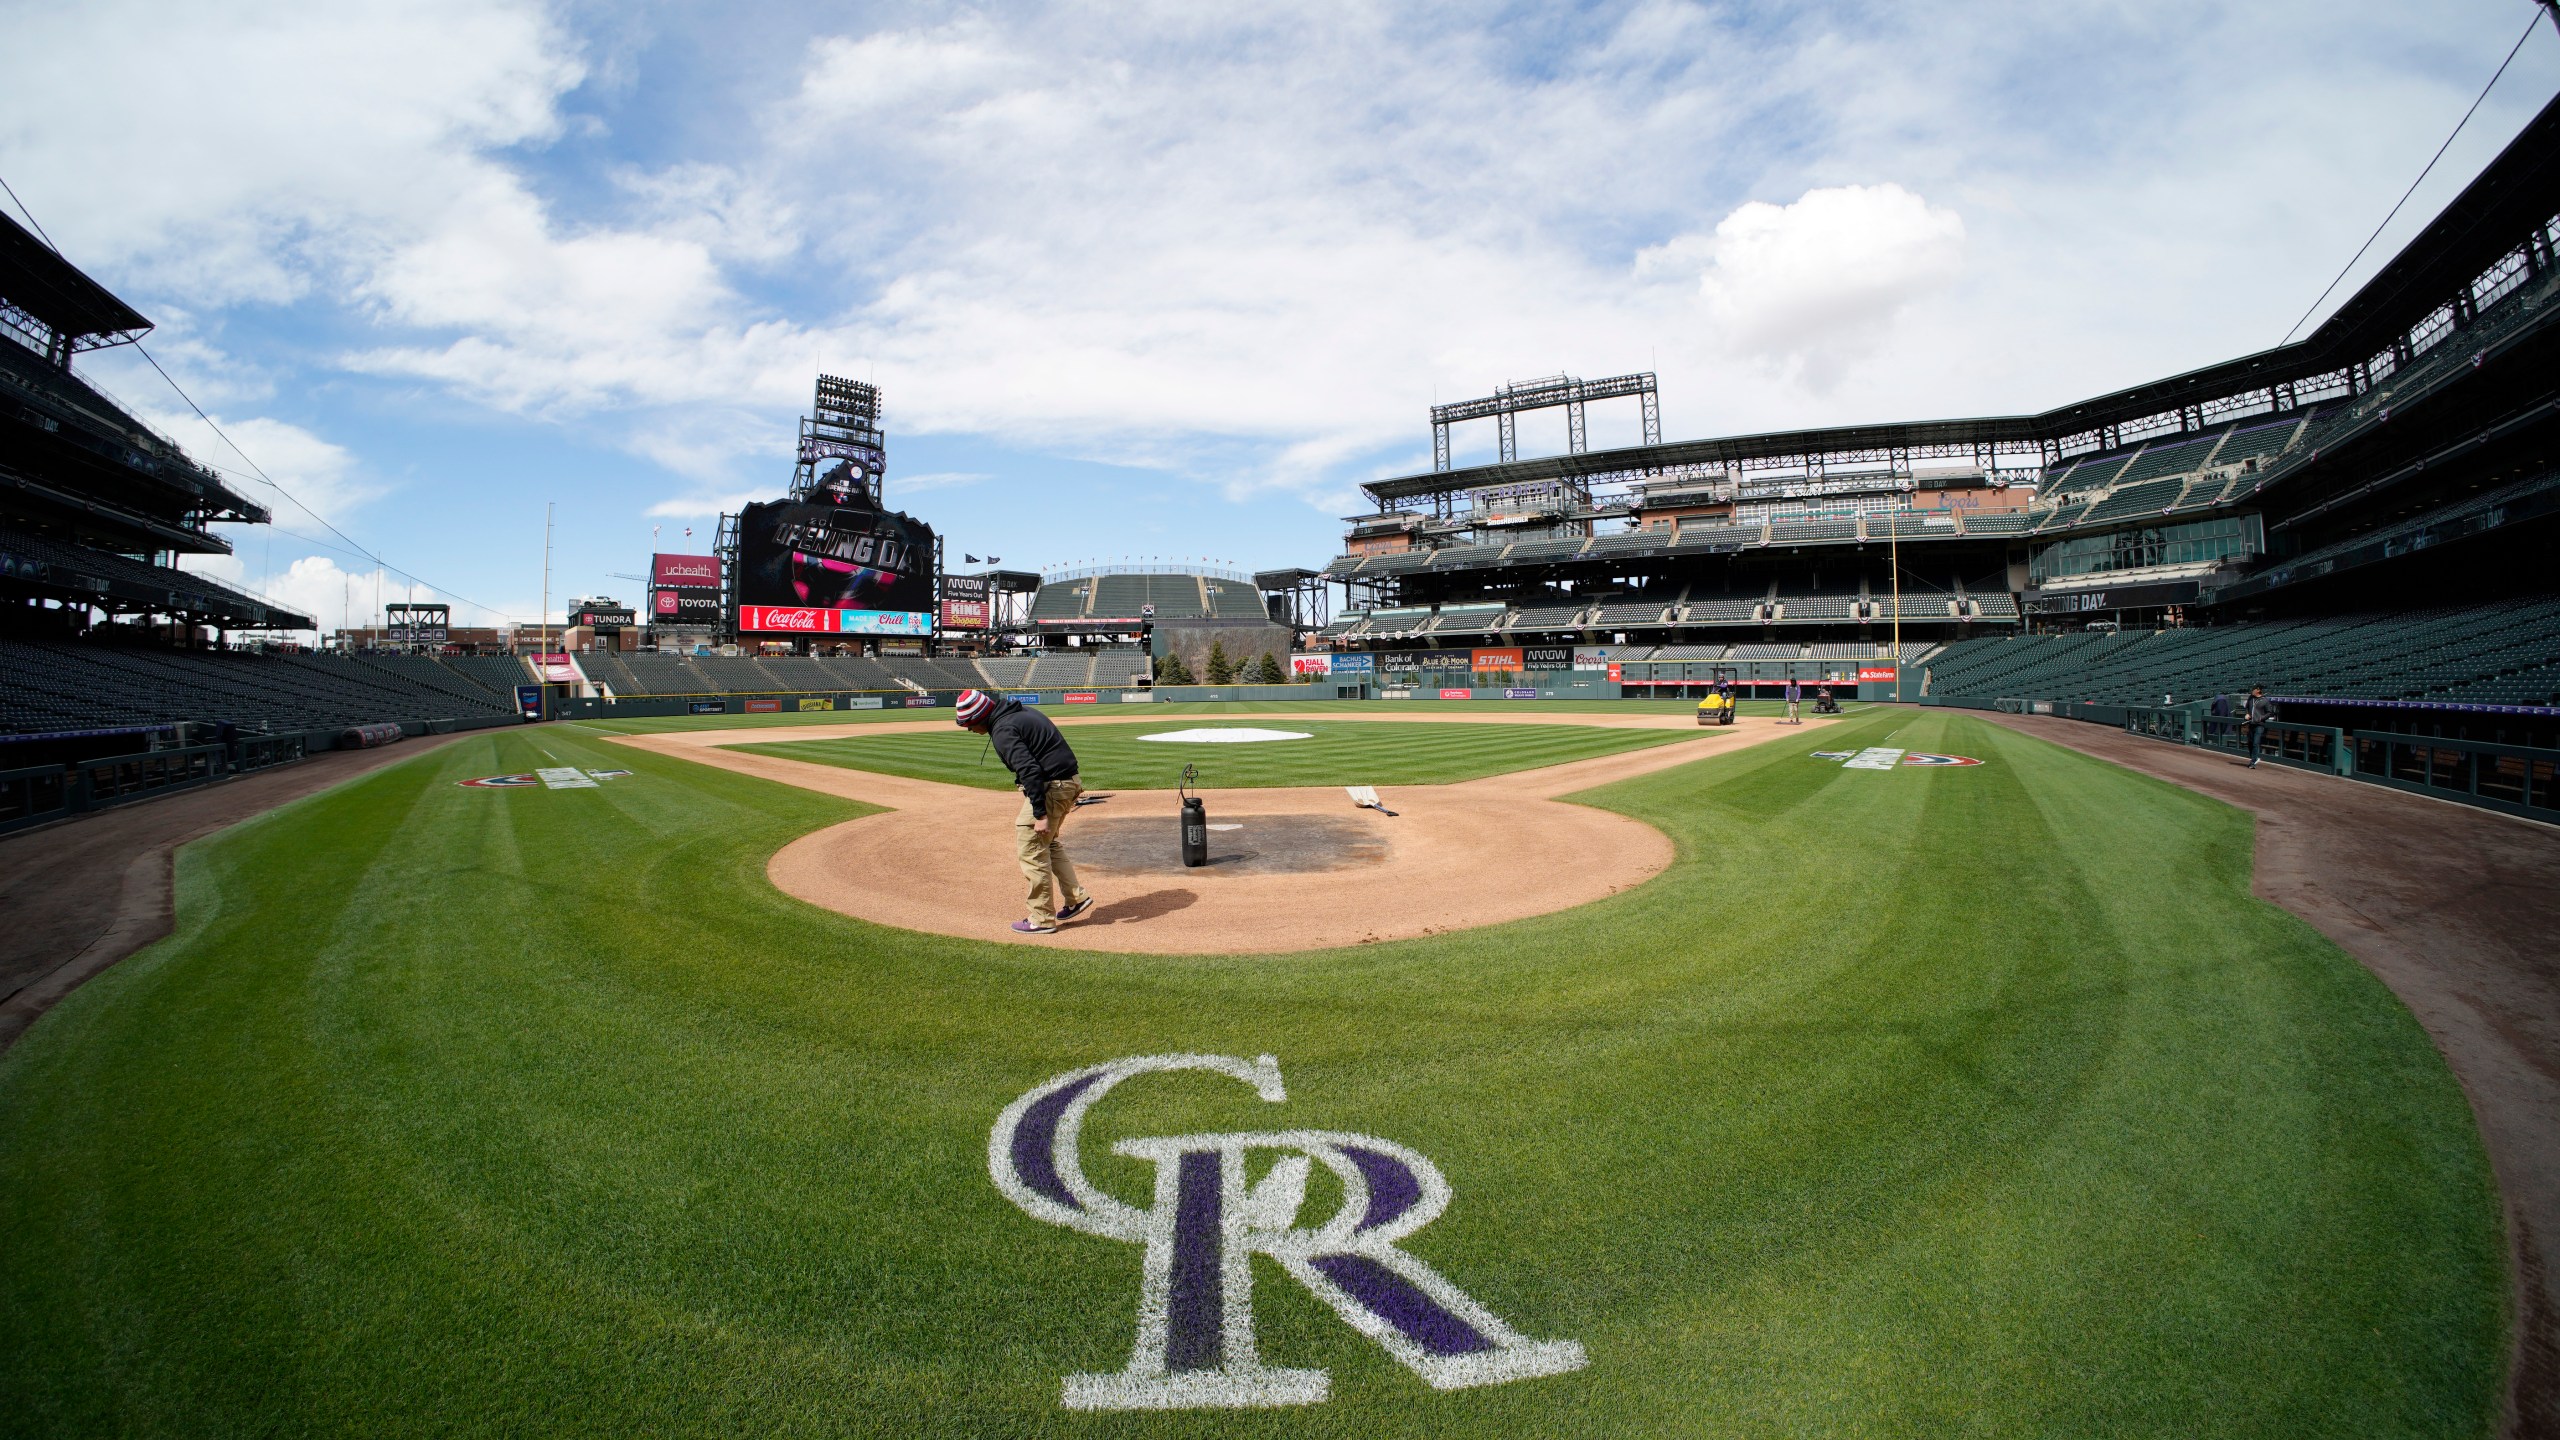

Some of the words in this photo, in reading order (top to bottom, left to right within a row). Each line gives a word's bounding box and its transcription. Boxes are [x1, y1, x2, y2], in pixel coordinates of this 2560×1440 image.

[1939, 493, 1979, 508] Coors
[771, 523, 875, 564] OPENING
[665, 563, 711, 578] uchealth
[679, 598, 719, 609] TOYOTA
[951, 603, 981, 616] KING
[594, 614, 632, 624] TUNDRA
[766, 609, 816, 628] Coca-Cola
[879, 613, 905, 625] Chill
[951, 615, 981, 626] Soopers
[1385, 653, 1404, 663] Bank
[1404, 653, 1413, 663] of
[1422, 656, 1439, 666] BLUE
[1478, 655, 1517, 665] STIHL
[1575, 653, 1602, 665] Coors
[1385, 661, 1419, 672] Colorado
[907, 698, 936, 706] BETFRED
